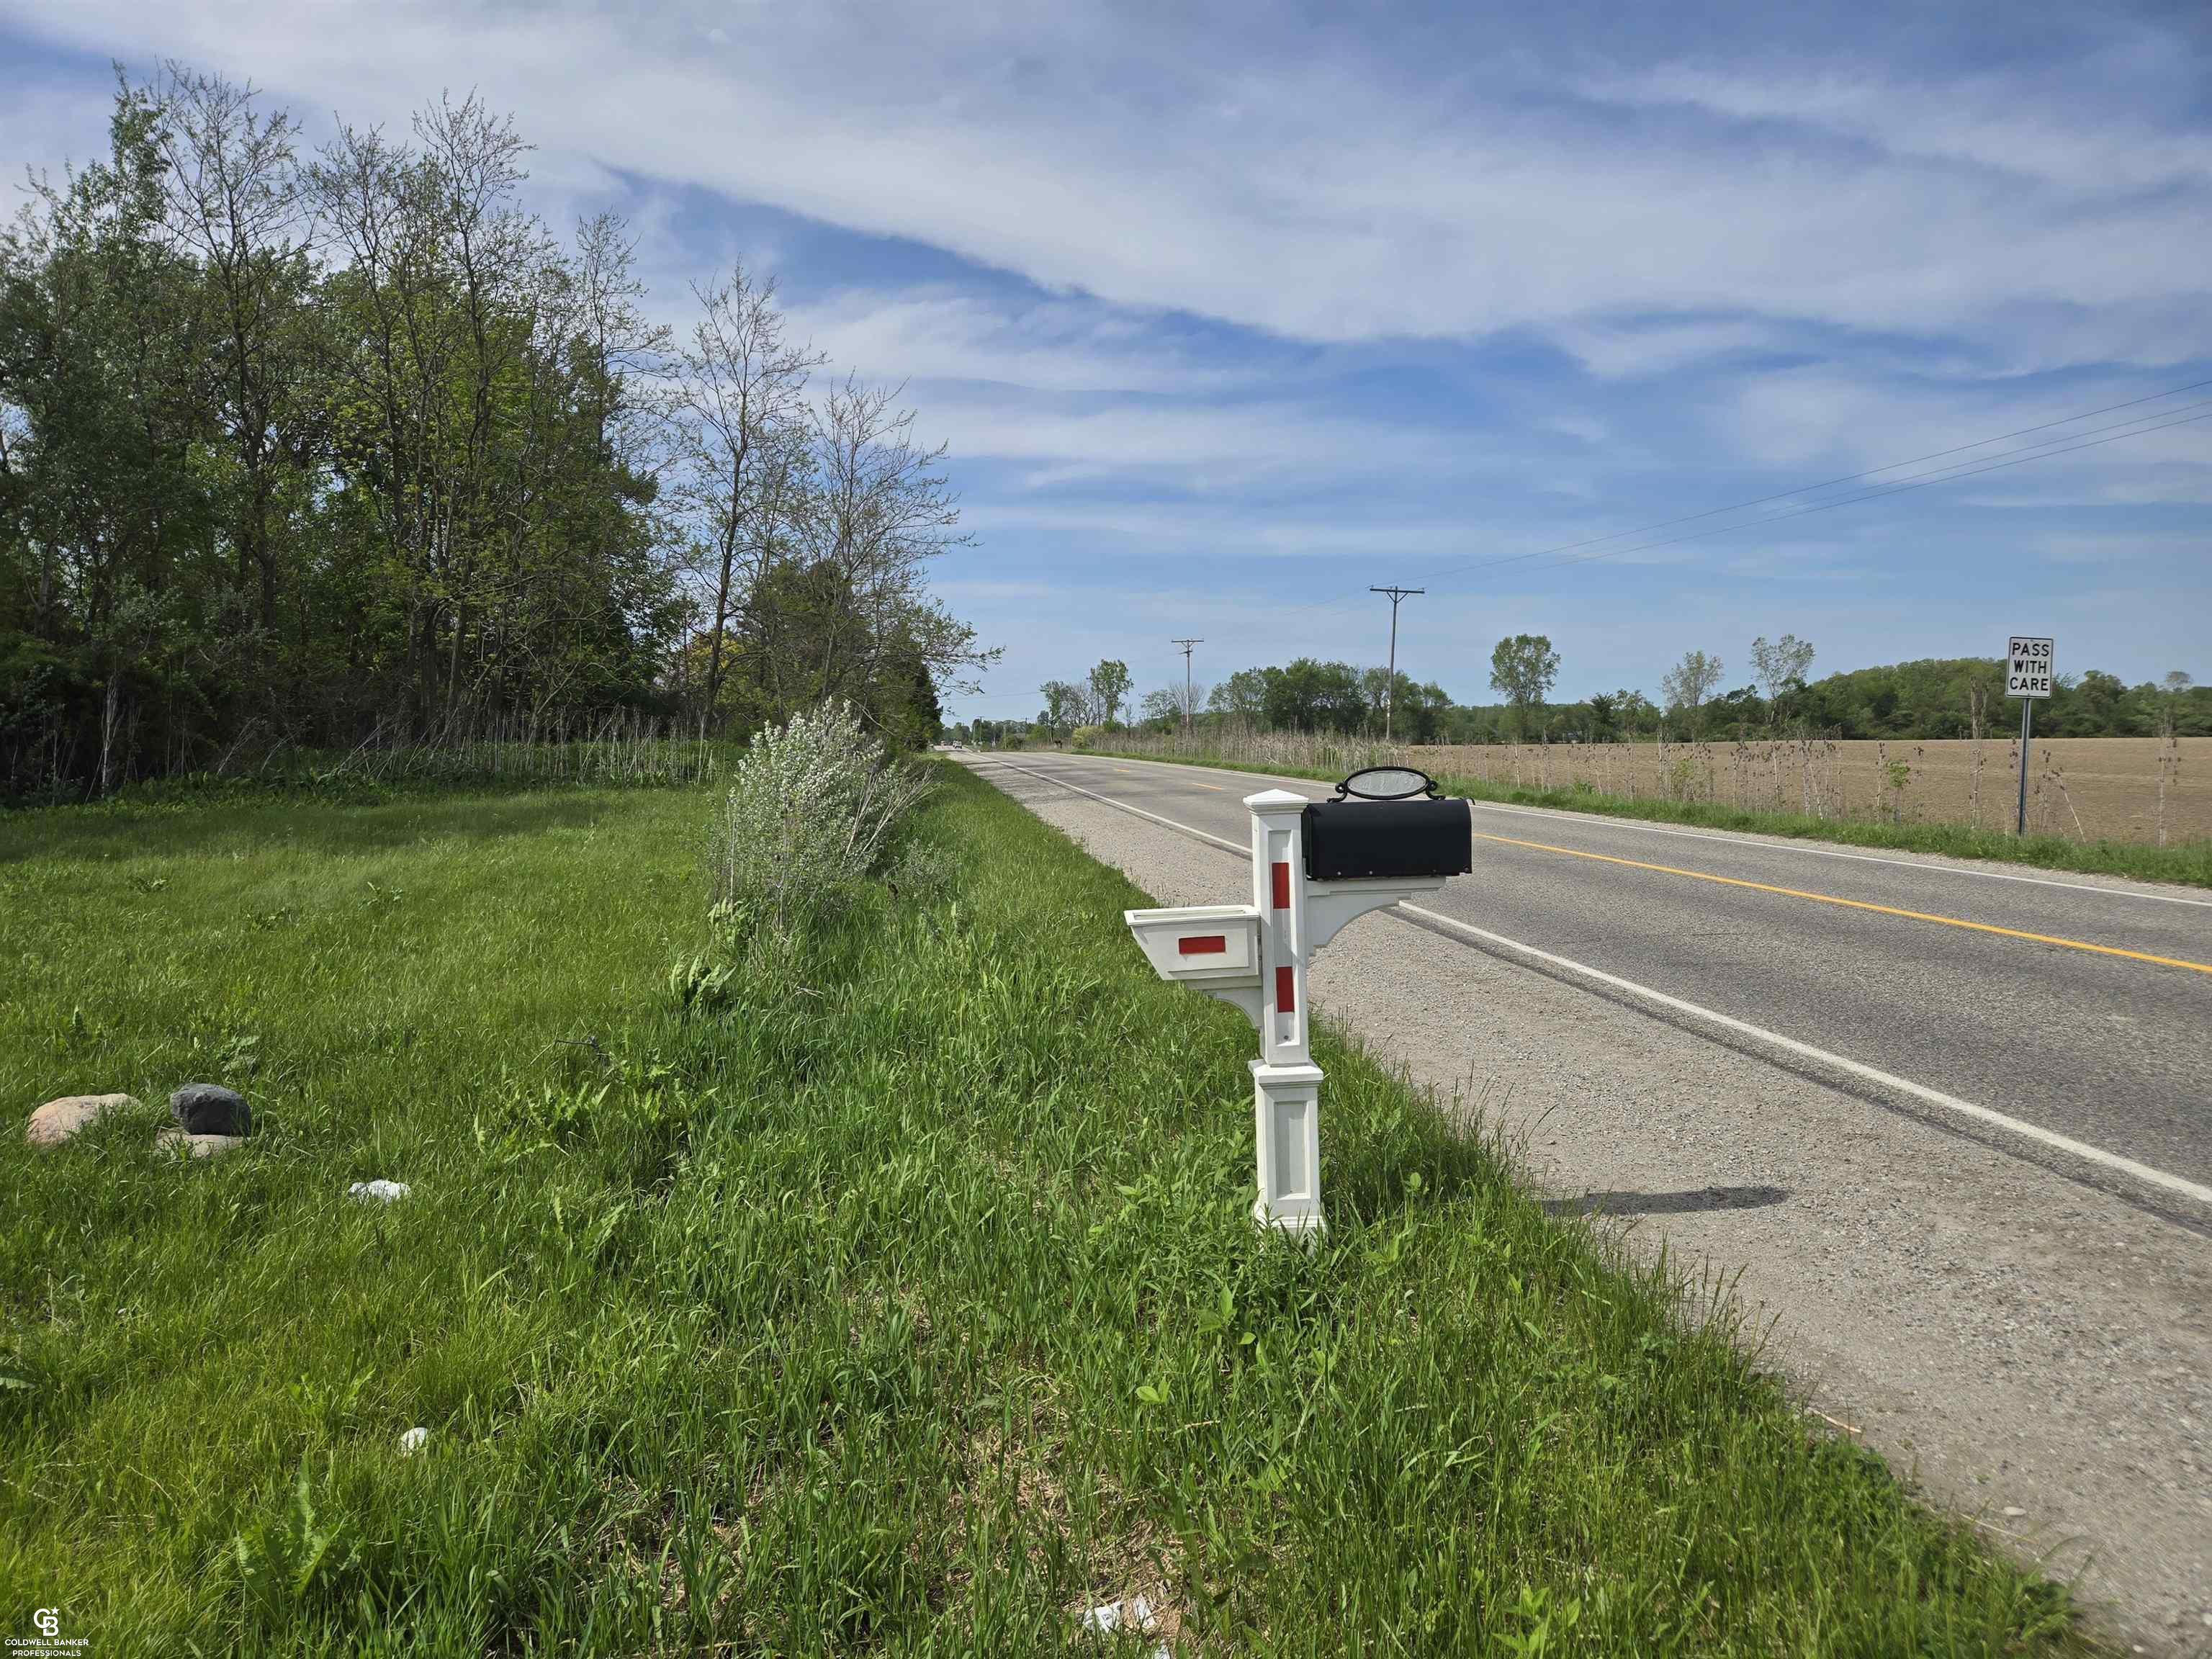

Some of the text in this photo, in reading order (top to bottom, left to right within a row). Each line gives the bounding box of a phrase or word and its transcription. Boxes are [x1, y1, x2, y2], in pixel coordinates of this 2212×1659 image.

[2012, 642, 2049, 657] PASS
[2014, 660, 2046, 674] WITH
[2010, 677, 2049, 691] CARE
